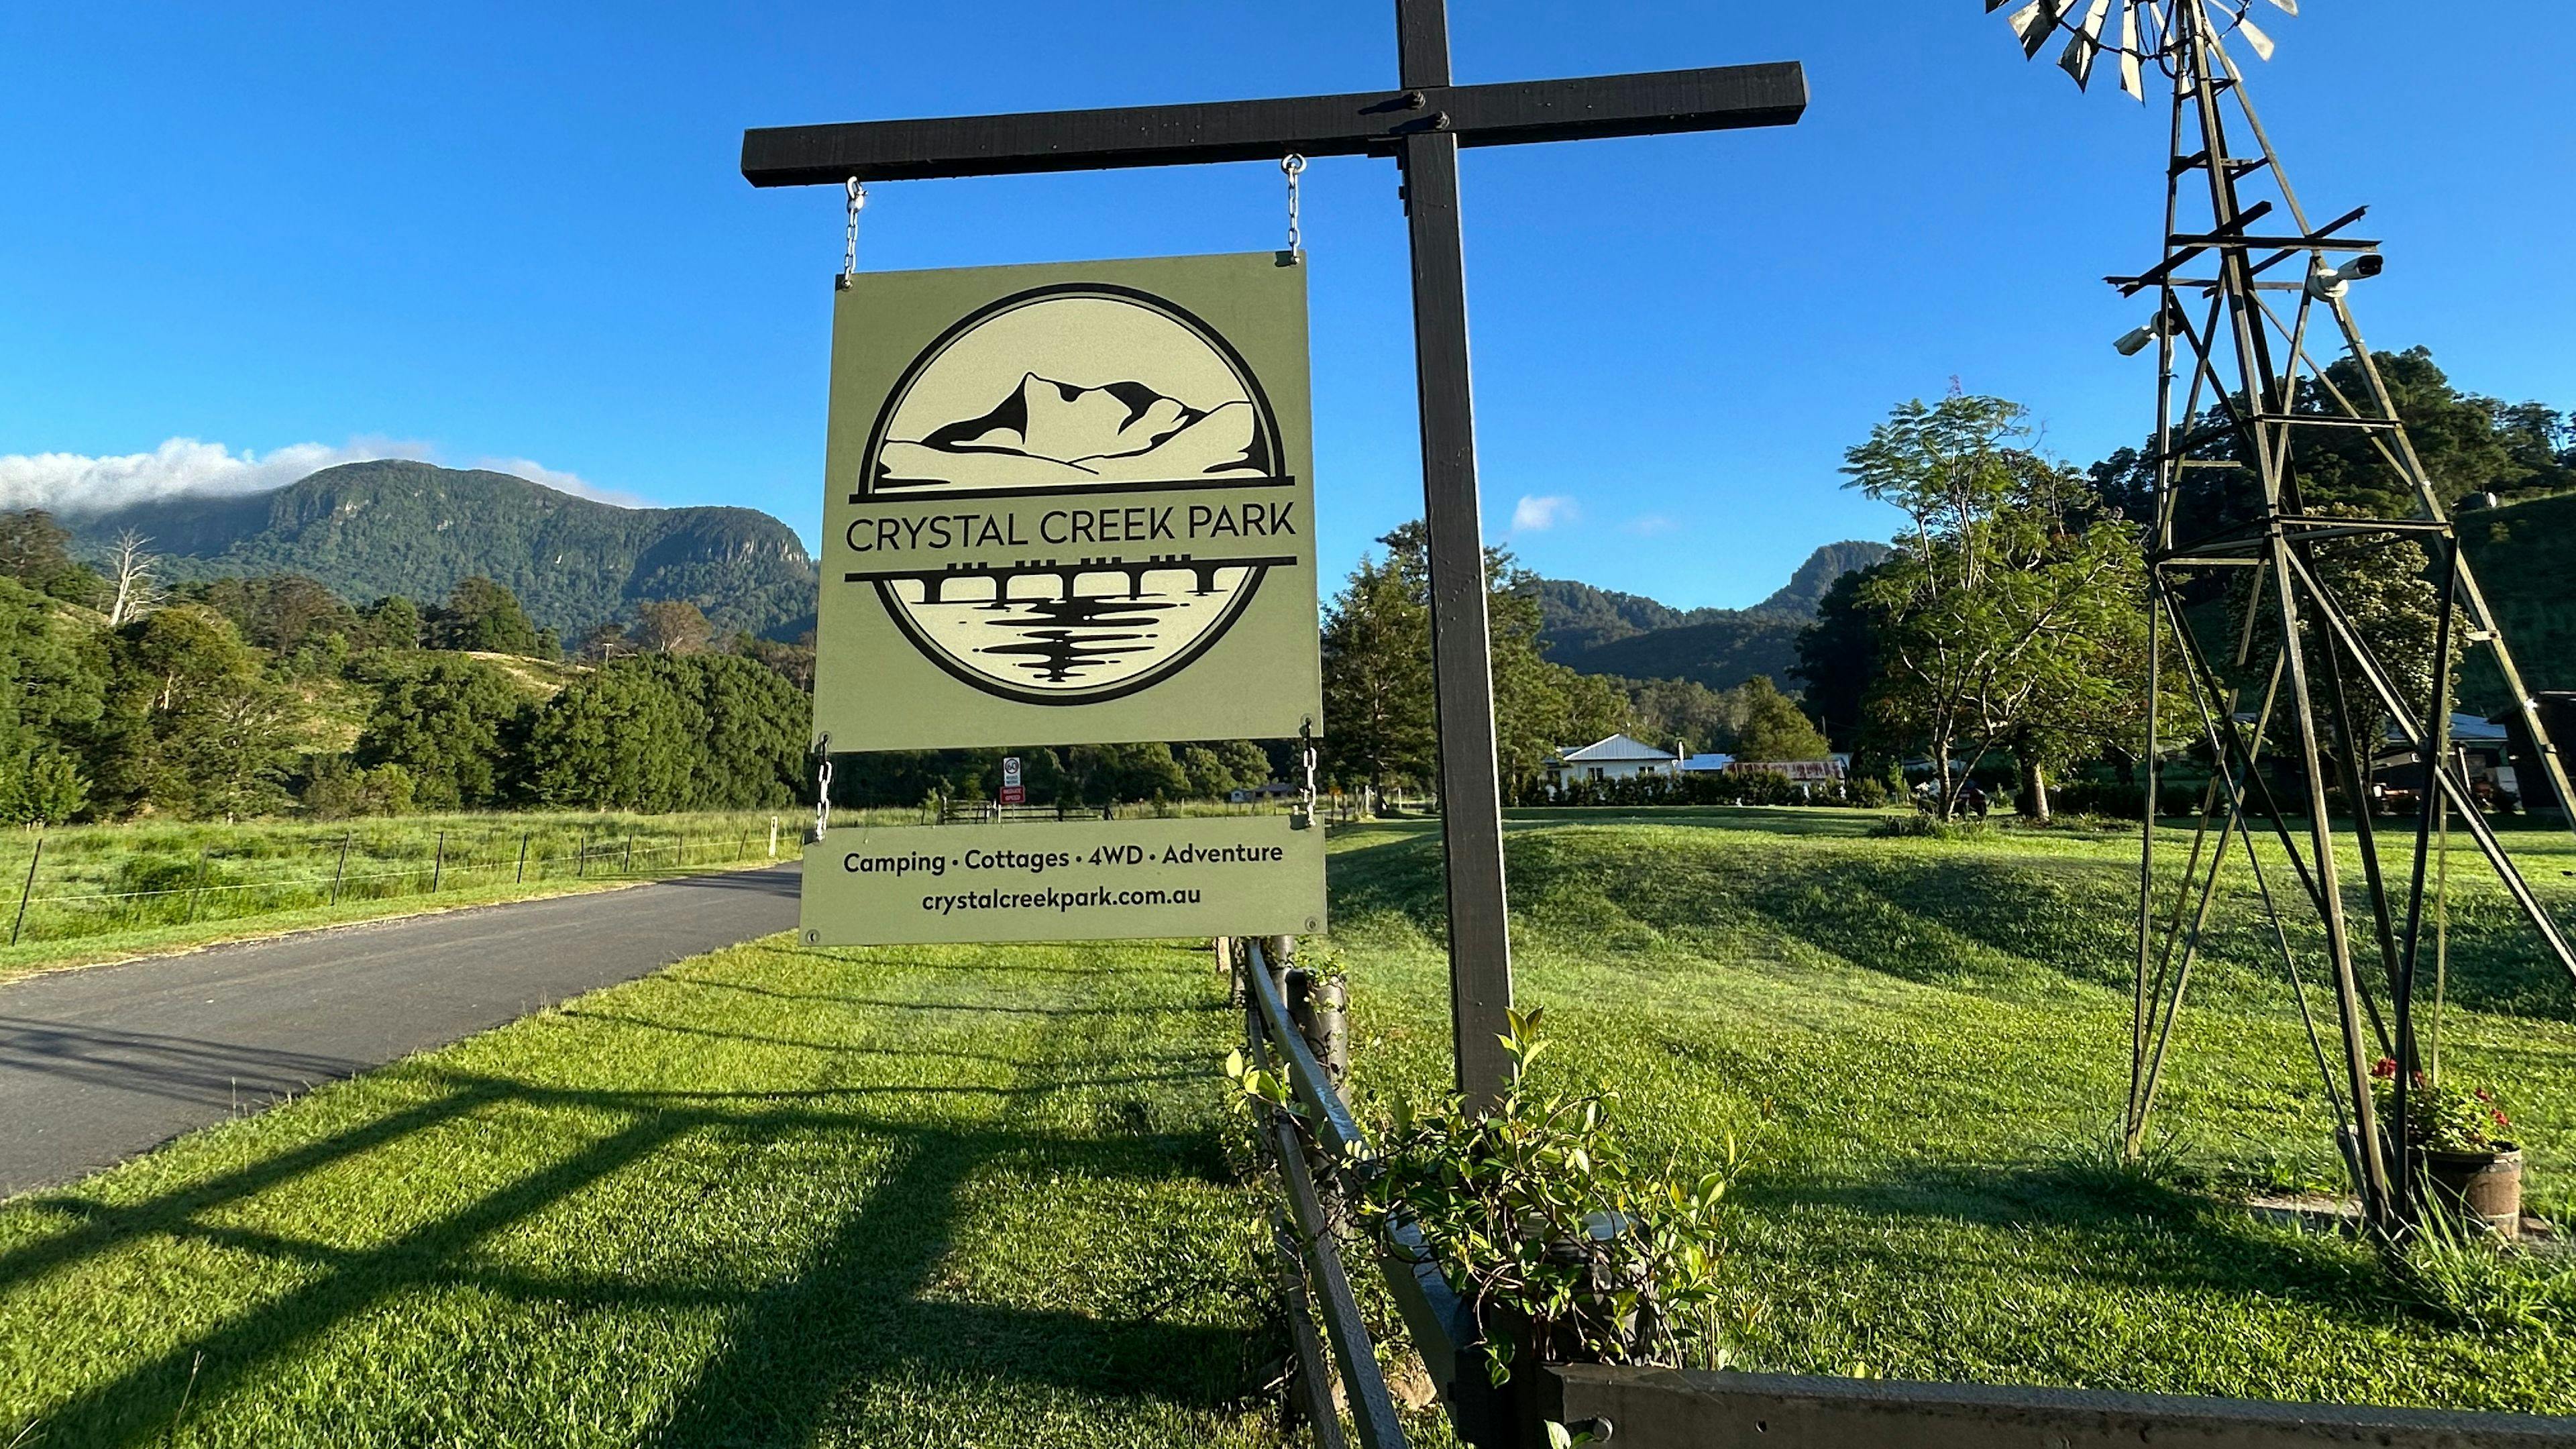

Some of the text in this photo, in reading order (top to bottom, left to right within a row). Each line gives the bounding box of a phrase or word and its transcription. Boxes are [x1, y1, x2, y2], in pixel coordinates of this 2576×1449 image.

[846, 502, 1297, 552] CRYSTAL CREEK PARK
[843, 843, 1283, 877] Camping Cottages 4WD Adventure
[922, 885, 1201, 914] crystalcreekpark.com.au
